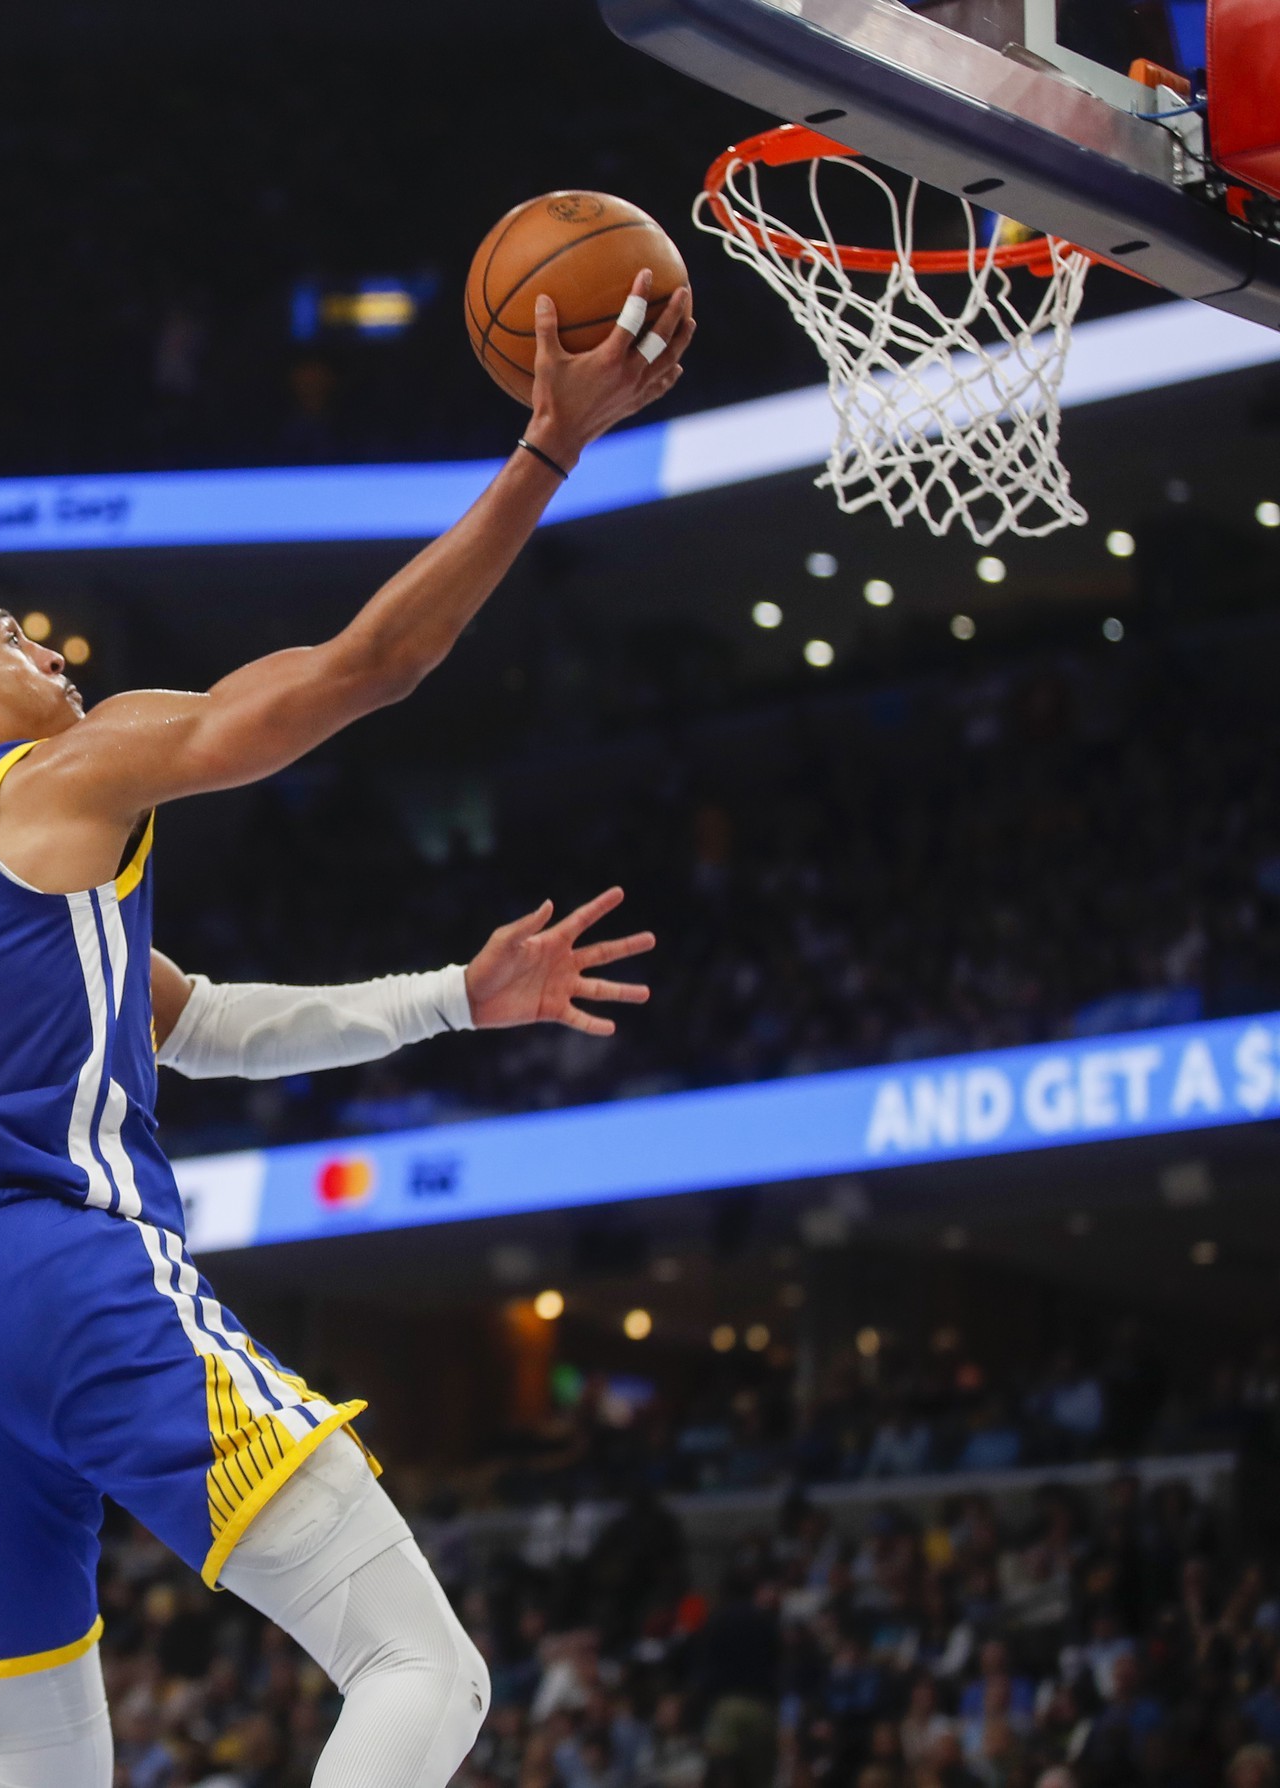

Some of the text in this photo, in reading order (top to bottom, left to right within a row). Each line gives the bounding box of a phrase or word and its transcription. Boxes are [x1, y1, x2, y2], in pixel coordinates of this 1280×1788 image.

[865, 1066, 1013, 1156] AND
[1022, 1045, 1161, 1135] GET
[1169, 1038, 1223, 1118] A
